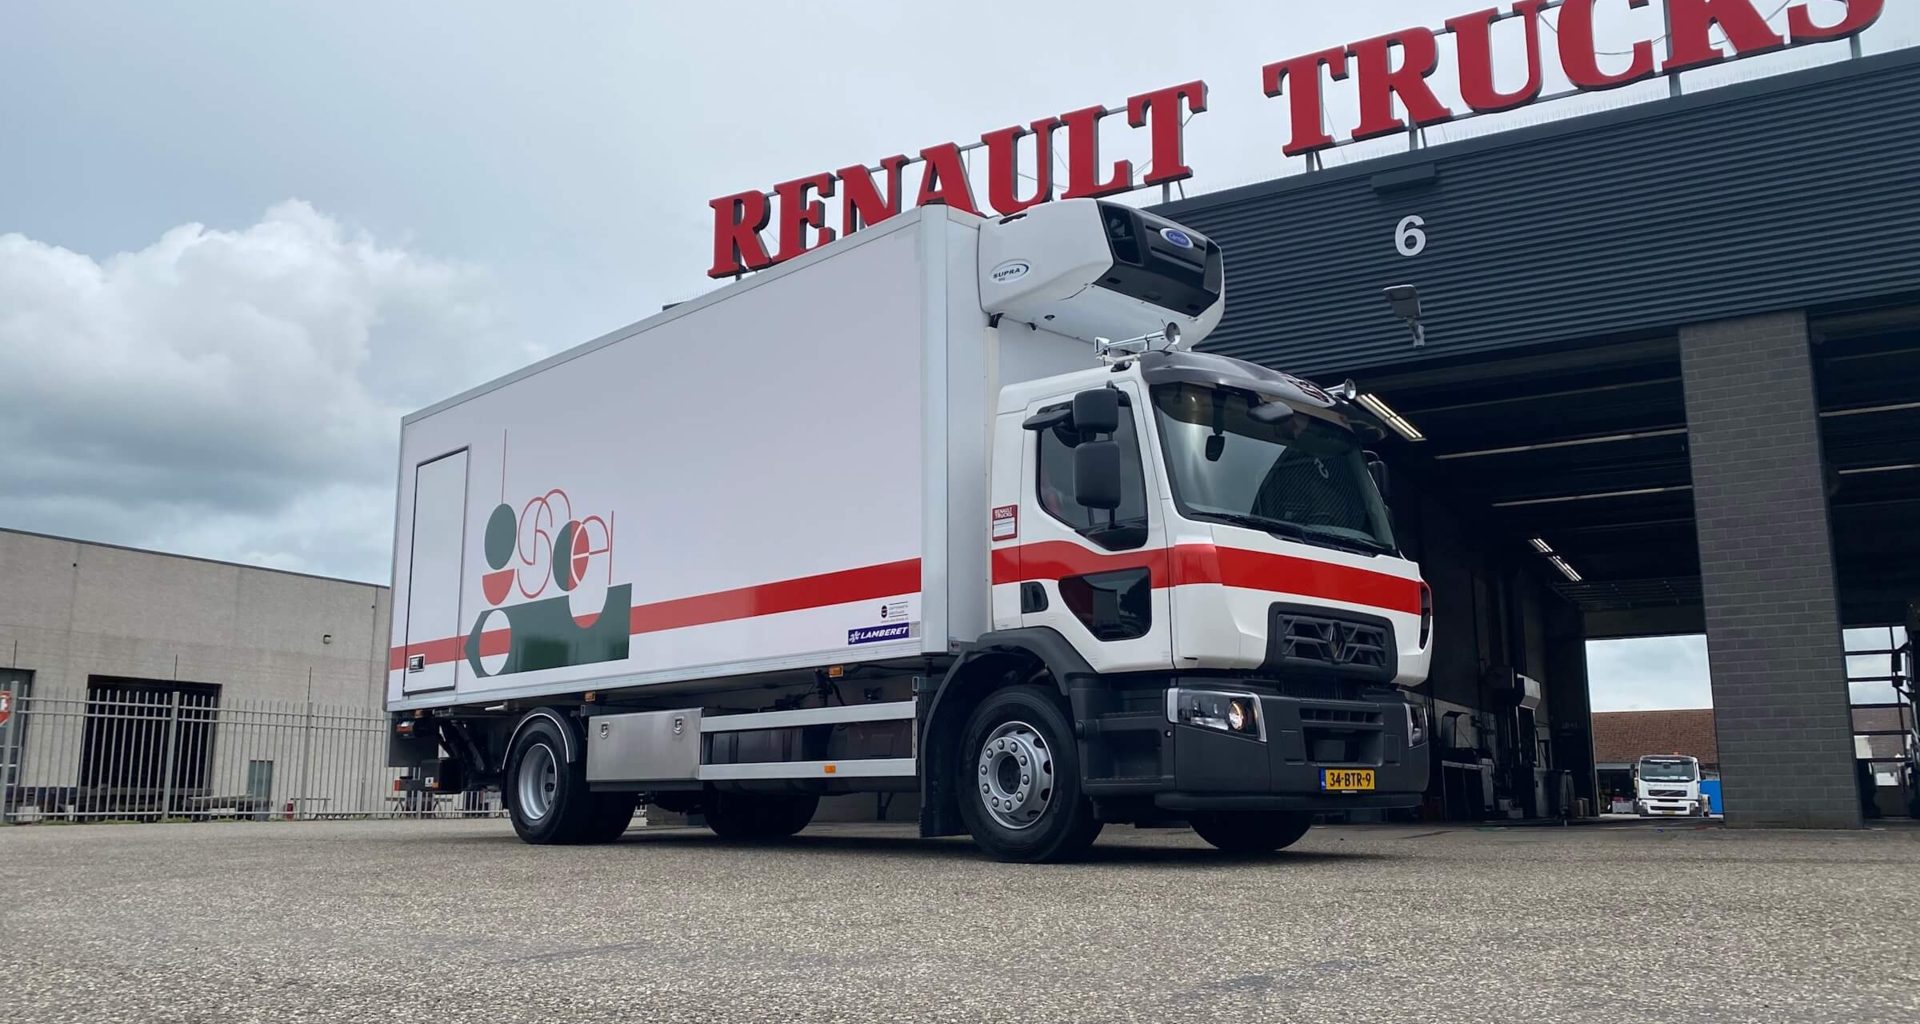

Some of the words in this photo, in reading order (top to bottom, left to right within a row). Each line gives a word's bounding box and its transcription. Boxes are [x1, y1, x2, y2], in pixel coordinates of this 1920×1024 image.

[707, 80, 1208, 278] RENAULT
[1394, 215, 1427, 256] 6
[993, 268, 1020, 278] SUPRA
[860, 627, 908, 639] LAMBERET
[1330, 773, 1371, 787] 34-BTR-9
